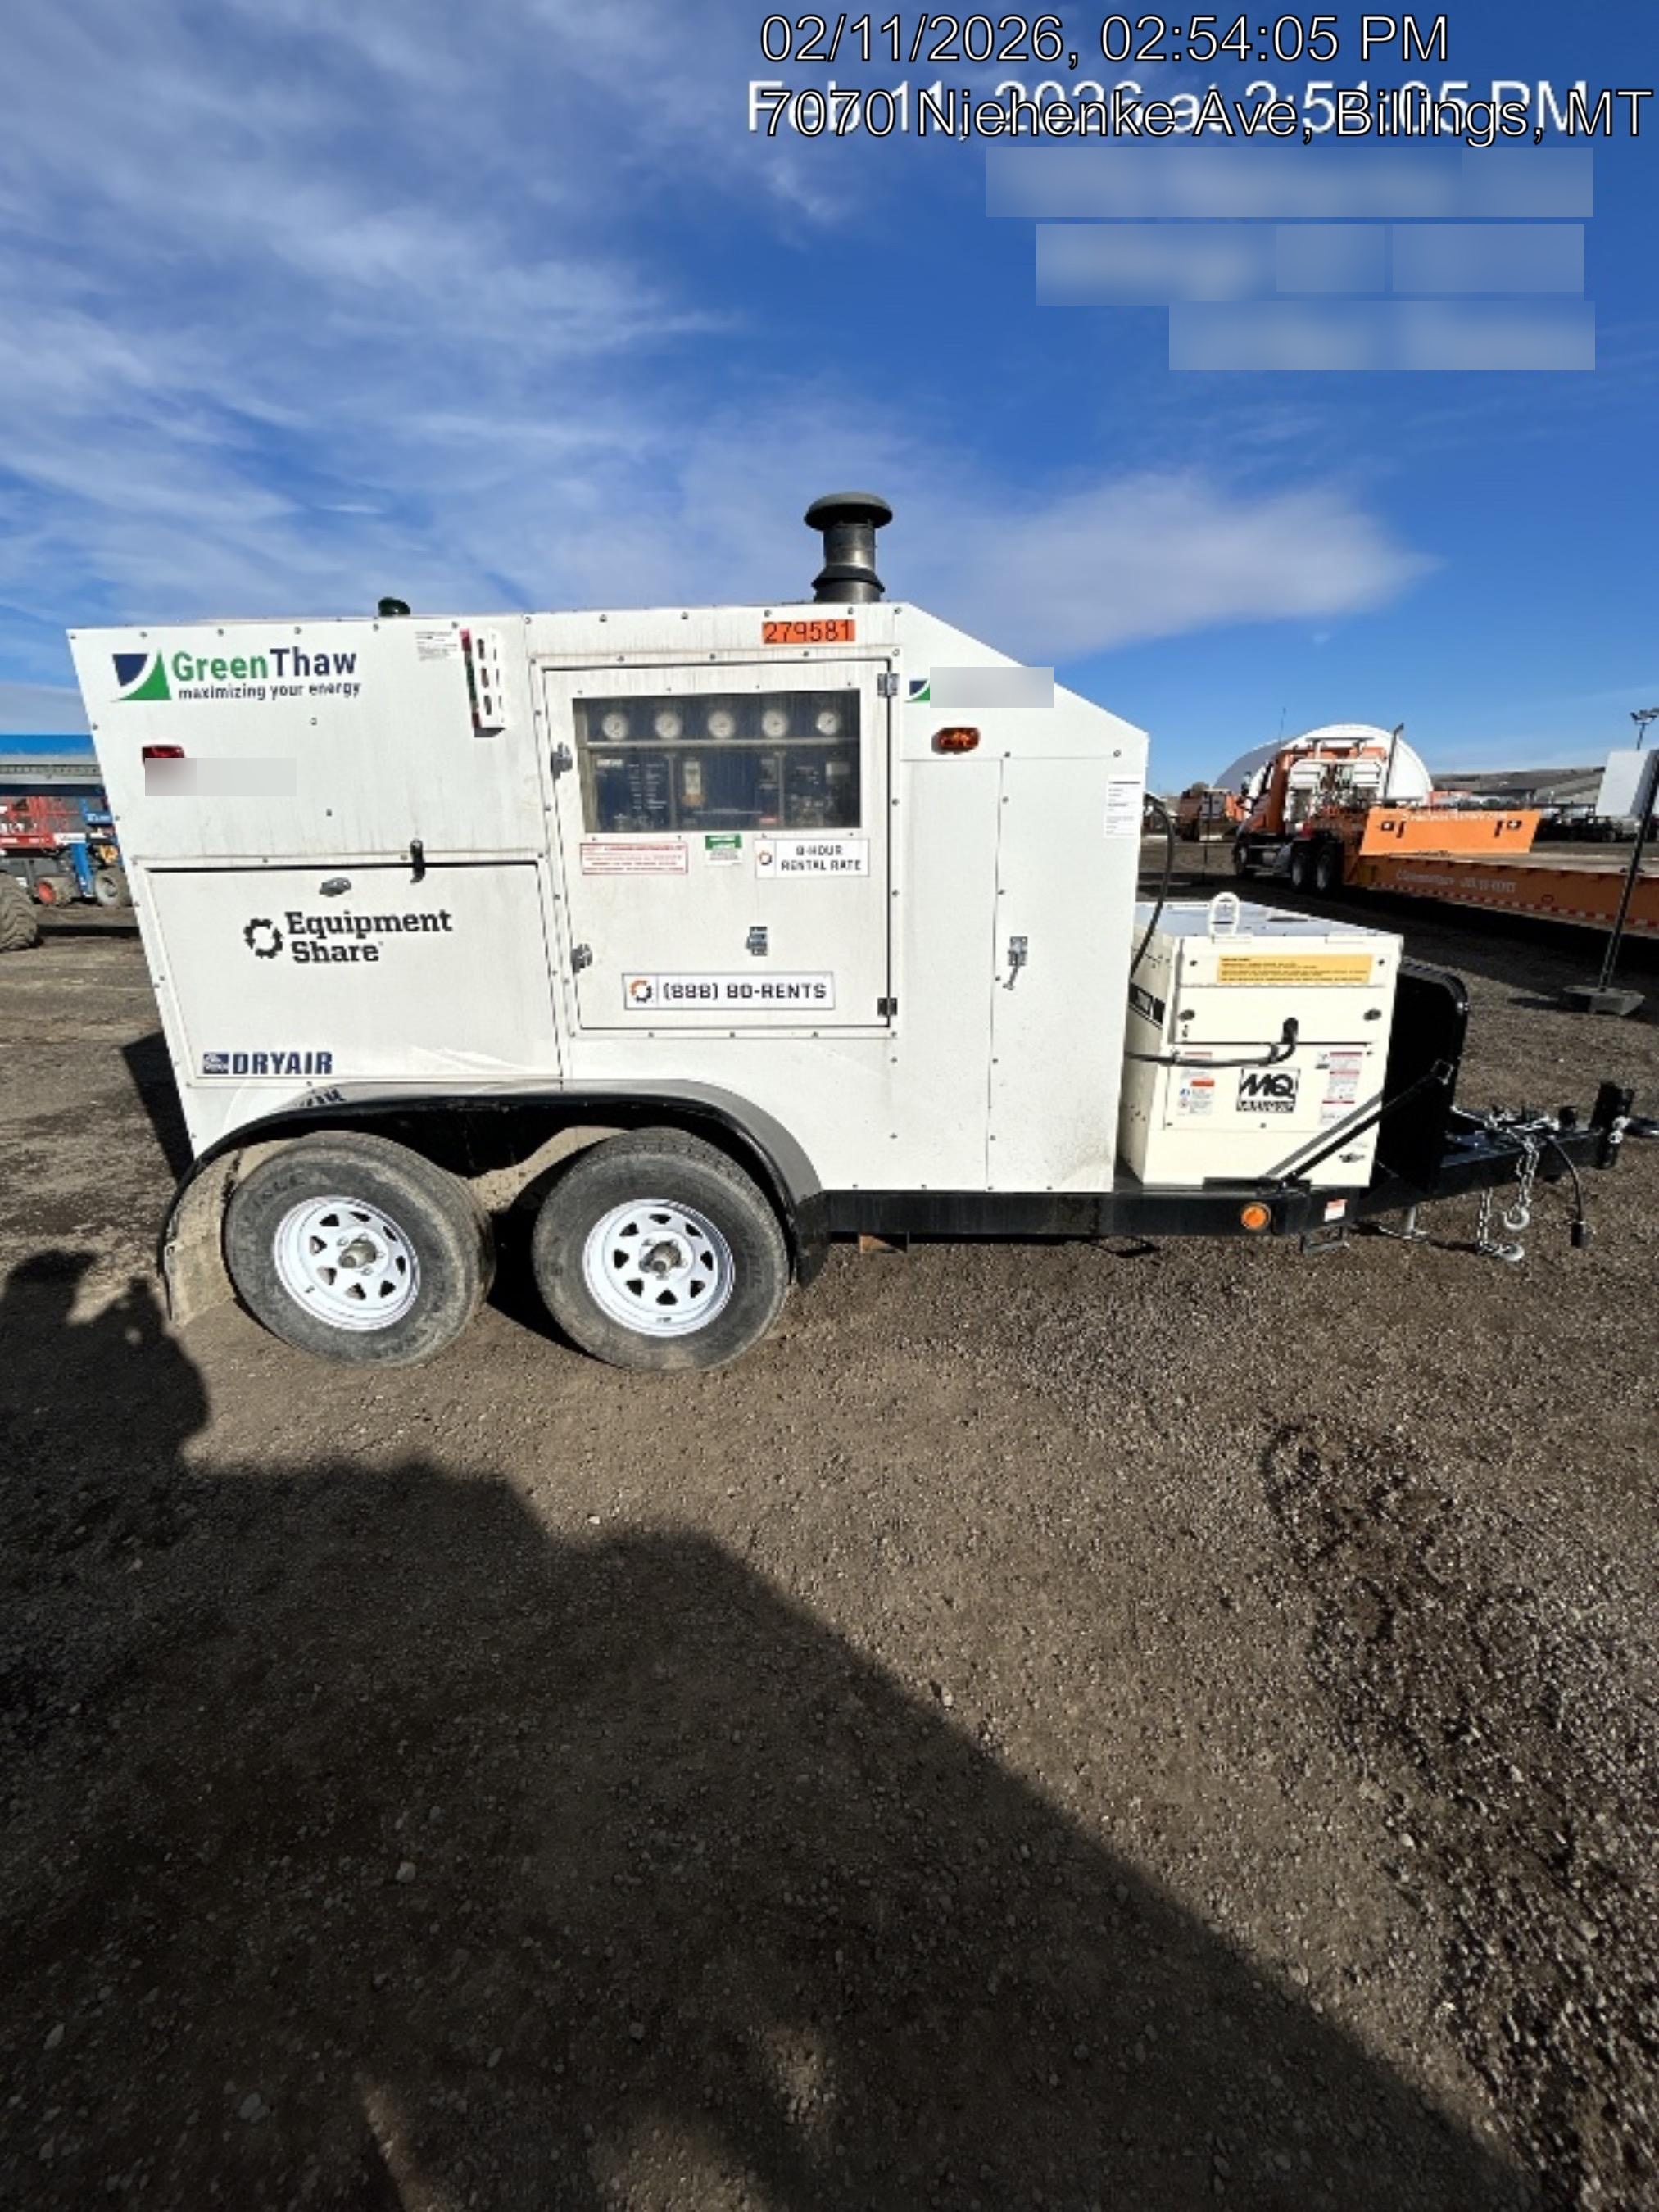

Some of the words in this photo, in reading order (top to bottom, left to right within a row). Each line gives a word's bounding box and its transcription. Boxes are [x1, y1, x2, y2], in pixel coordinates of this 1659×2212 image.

[764, 619, 849, 643] 279581
[171, 646, 356, 682] GreenThaw
[178, 682, 265, 701] maximizing
[270, 683, 304, 701] your
[308, 680, 361, 697] energy
[830, 859, 862, 871] RATE
[284, 909, 453, 940] Equipment
[291, 940, 379, 963] Share
[662, 982, 719, 1001] (888)
[726, 982, 827, 999] 80-RENTS
[232, 1051, 333, 1075] DRYAIR
[1239, 1072, 1296, 1103] MQ
